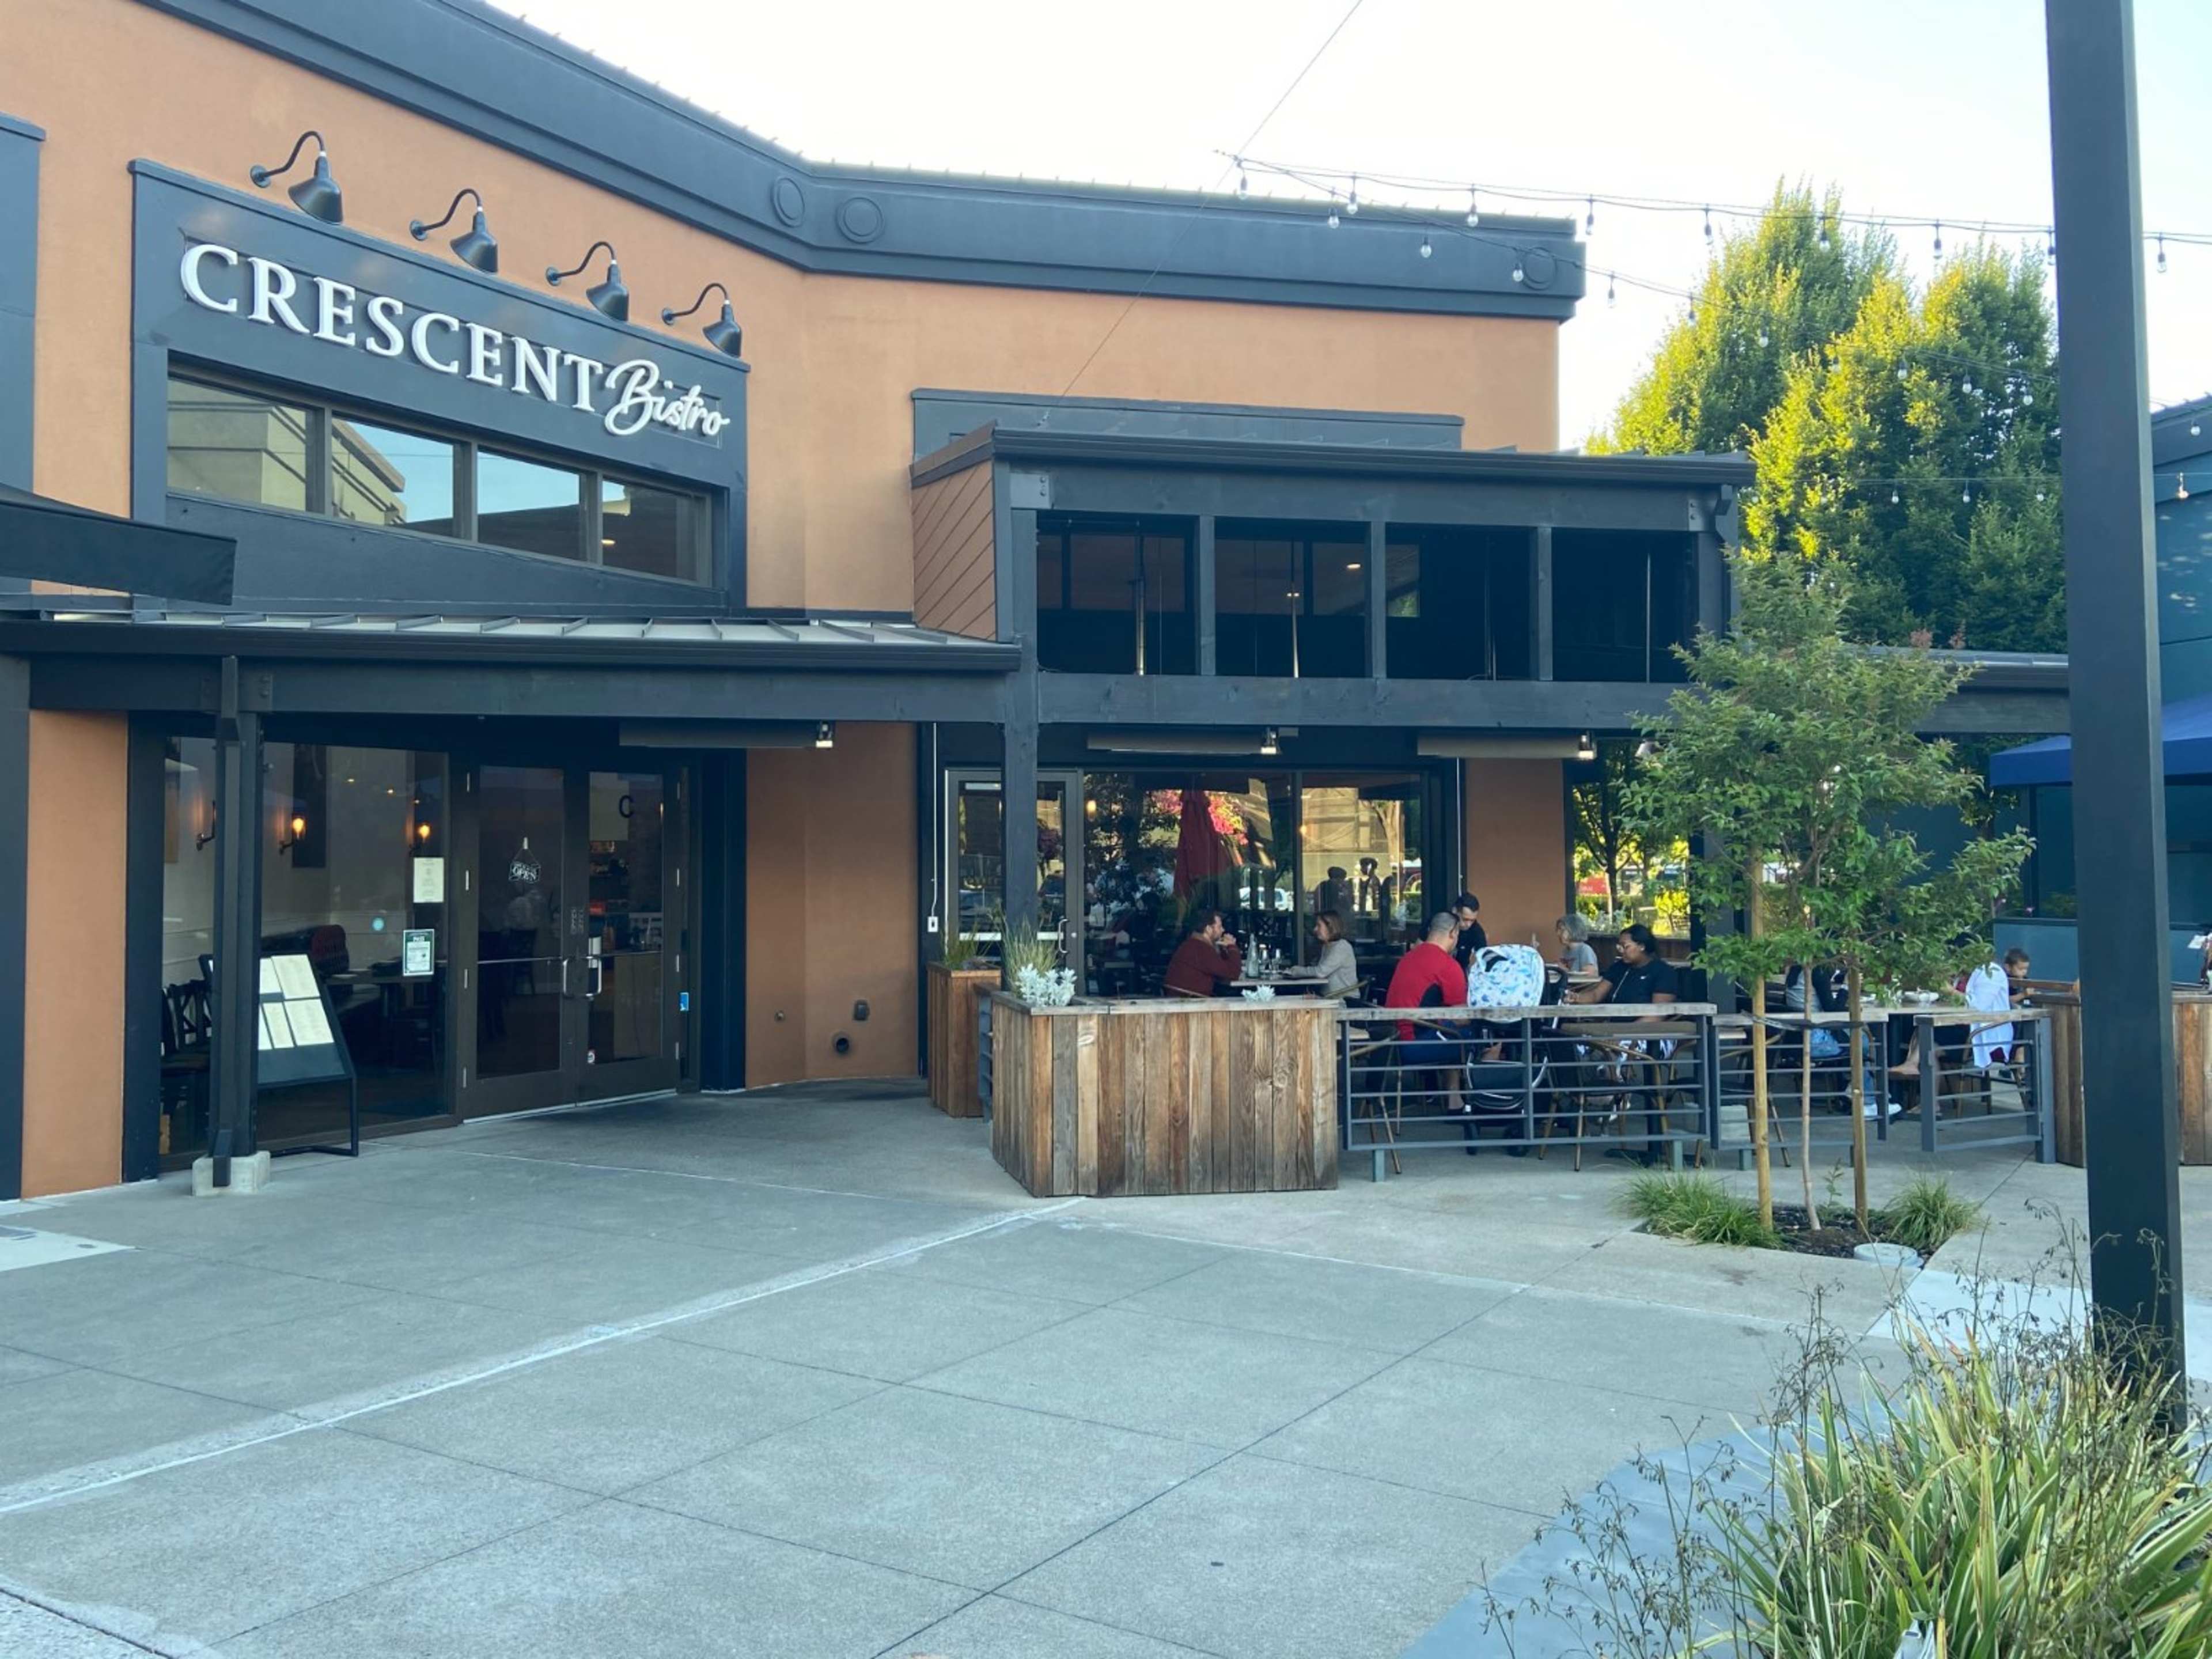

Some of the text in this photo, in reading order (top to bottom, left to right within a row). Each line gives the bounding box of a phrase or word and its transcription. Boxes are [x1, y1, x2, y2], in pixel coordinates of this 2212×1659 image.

[180, 244, 730, 435] CRESCENT Bistro
[619, 795, 634, 818] C
